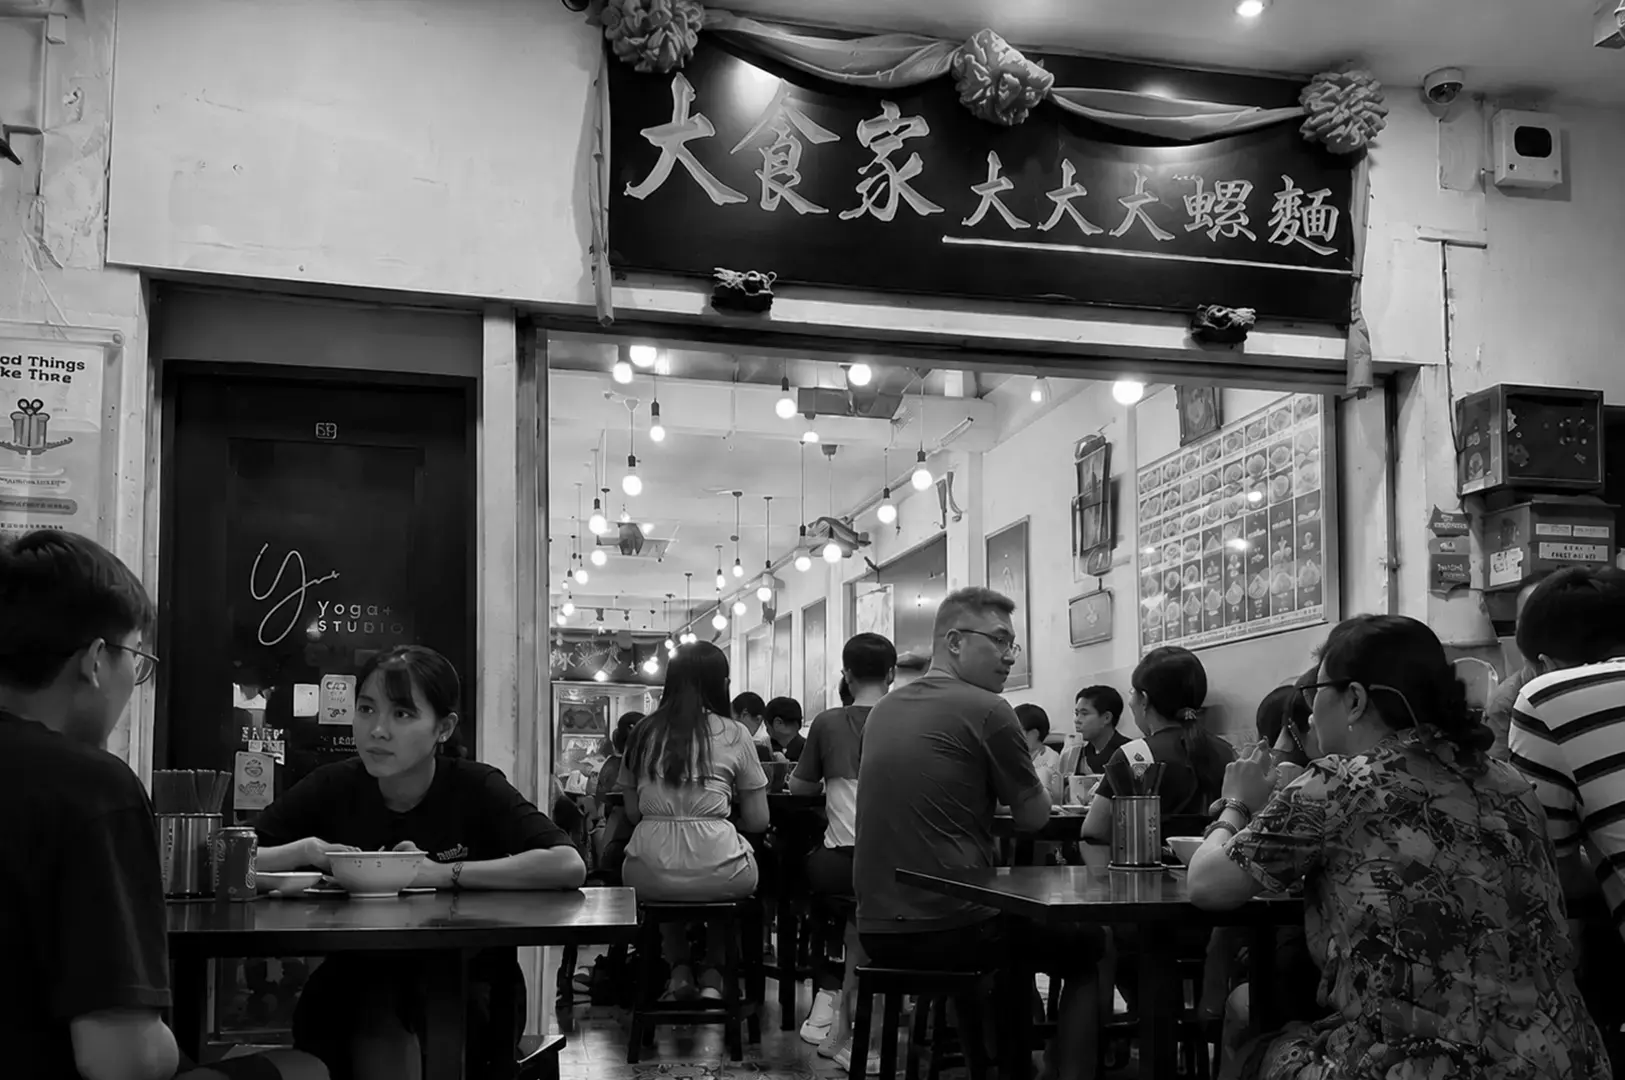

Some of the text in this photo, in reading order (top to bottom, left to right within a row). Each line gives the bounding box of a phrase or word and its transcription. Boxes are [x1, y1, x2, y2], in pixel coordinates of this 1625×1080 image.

[624, 71, 945, 221] 大食家
[28, 356, 86, 373] Things
[317, 619, 404, 634] STUDIO
